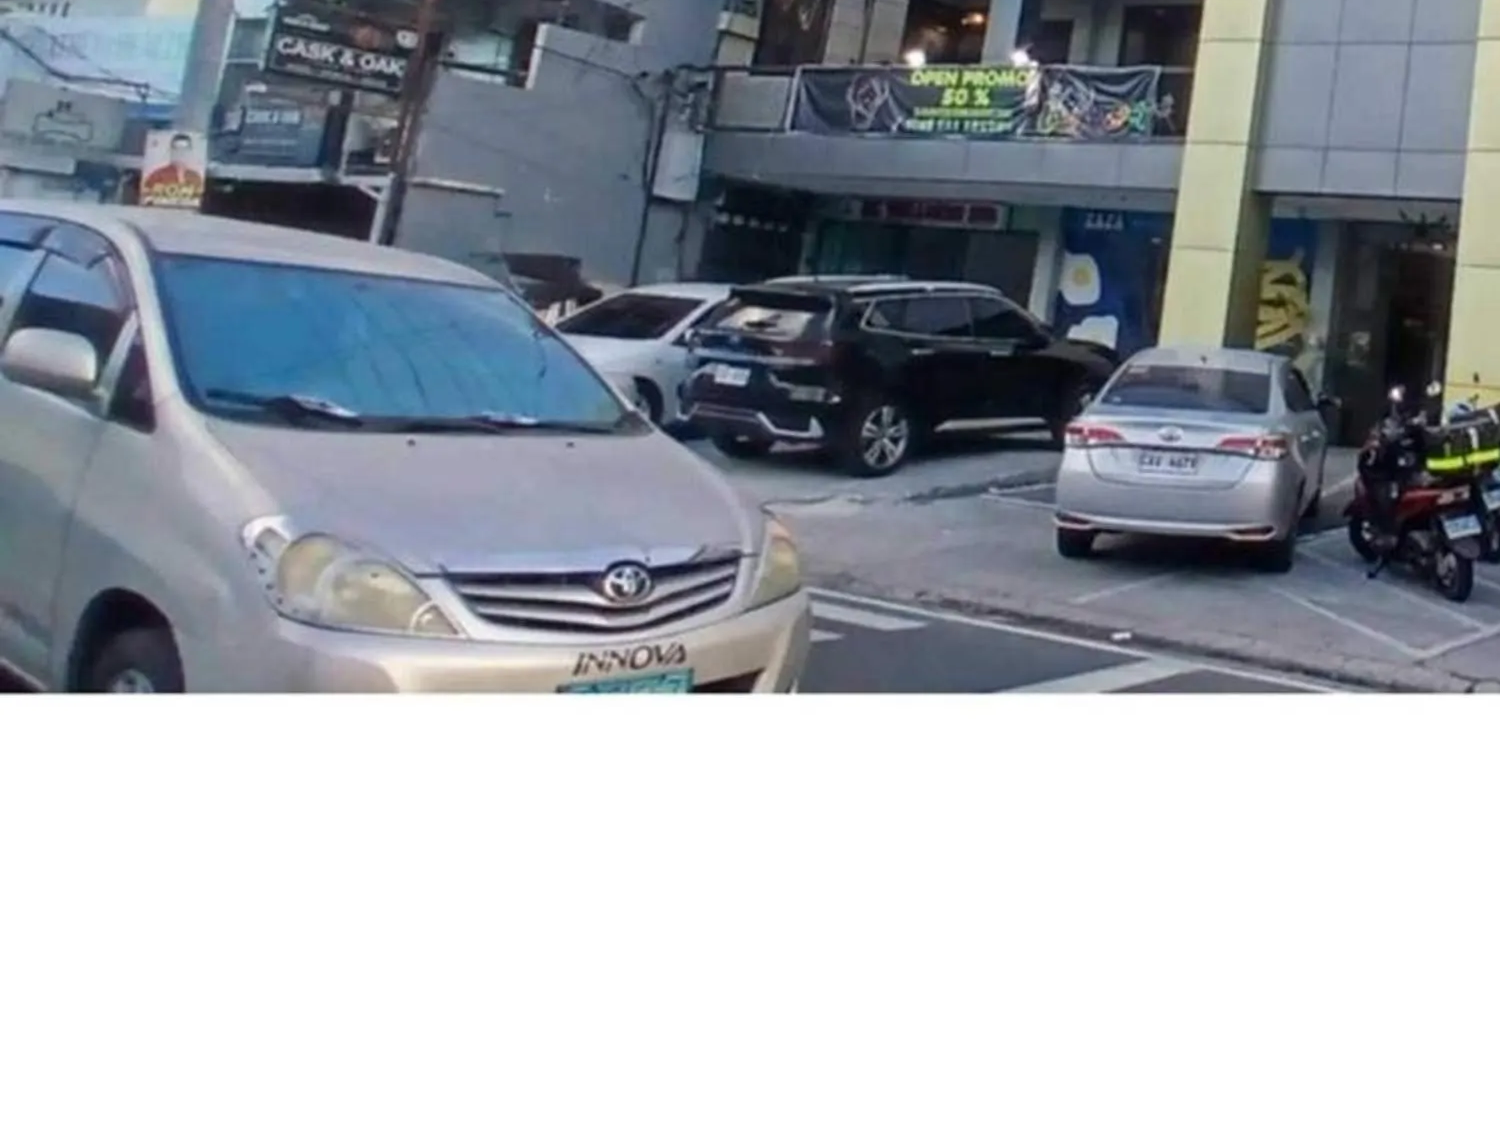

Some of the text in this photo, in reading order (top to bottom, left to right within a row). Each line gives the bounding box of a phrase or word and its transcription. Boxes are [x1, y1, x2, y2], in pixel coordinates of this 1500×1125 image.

[277, 36, 334, 63] CASK
[911, 68, 1029, 87] OPEN PROMO
[941, 88, 968, 107] 50
[572, 642, 687, 676] INNOVA
